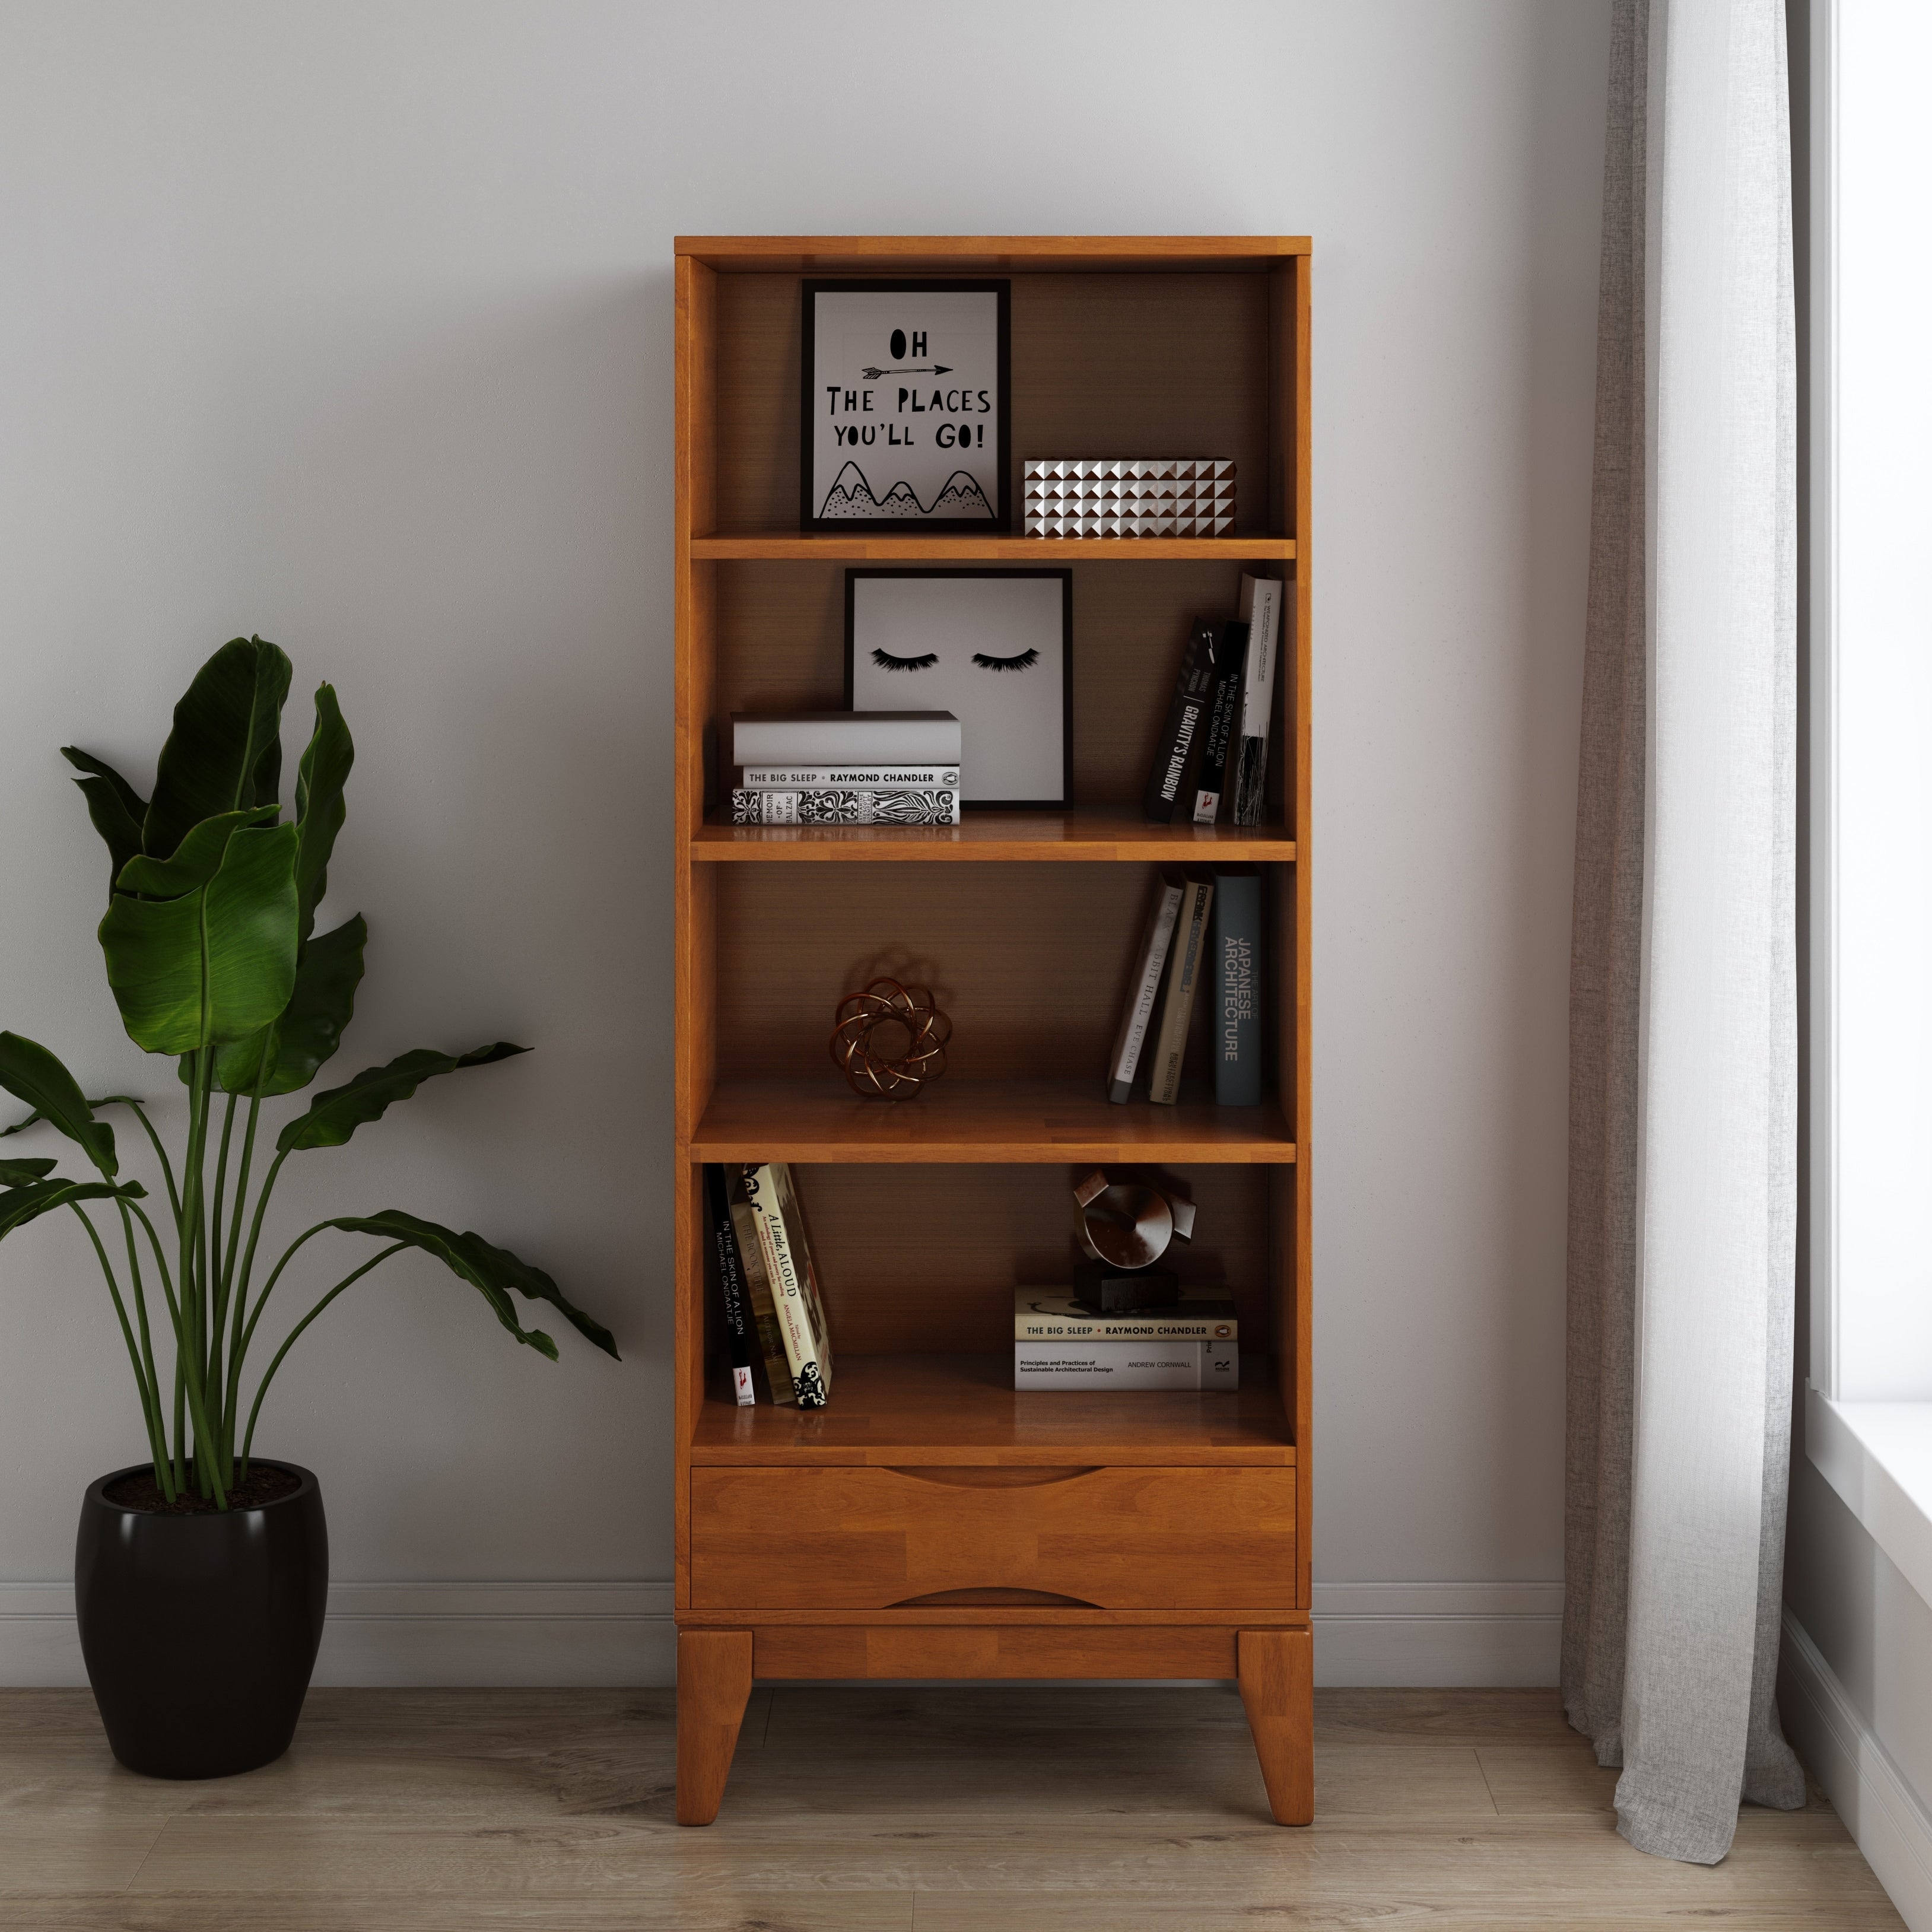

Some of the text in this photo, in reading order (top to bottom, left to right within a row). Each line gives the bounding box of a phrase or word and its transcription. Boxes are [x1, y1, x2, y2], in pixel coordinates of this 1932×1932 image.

[890, 329, 927, 360] OH
[827, 386, 991, 415] THE PLACES
[834, 423, 984, 449] YOU'LL GO!
[1187, 668, 1201, 692] PYNCHON
[1199, 672, 1210, 692] THOMAS
[1229, 673, 1238, 682] IN
[1226, 685, 1237, 702] THE
[1206, 680, 1226, 757] MICHAEL ONDAATJE
[1222, 703, 1233, 723] SKIN
[1221, 724, 1229, 738] OF
[1160, 706, 1199, 802] GRAVITY'S RAINBOW
[1215, 746, 1226, 767] LION
[750, 774, 934, 782] THE BIG SLEEP RAYMOND CHANDLER
[1162, 893, 1178, 931] BLACK
[1238, 938, 1251, 1019] JAPANESE
[1139, 985, 1154, 1015] HALL
[1225, 936, 1238, 1061] ARCHITECTURE
[1251, 1008, 1259, 1019] OF
[1124, 1025, 1143, 1075] EVE CHASE
[1162, 1053, 1174, 1101] CONSTRUCTIONS
[1167, 1053, 1179, 1101] ARCHITECTURAL
[723, 1221, 730, 1231] IN
[771, 1225, 786, 1251] Little,
[724, 1234, 733, 1254] THE
[727, 1257, 737, 1282] SKIN
[742, 1224, 765, 1292] THE BOOK TITLE
[716, 1232, 734, 1325] MICHAEL ONDAATJE
[778, 1253, 796, 1297] ALOUD
[731, 1283, 739, 1298] OF
[735, 1310, 743, 1335] LION
[784, 1304, 802, 1361] ANGELA MACMILLAN
[762, 1315, 779, 1365] AUTHOR NAME
